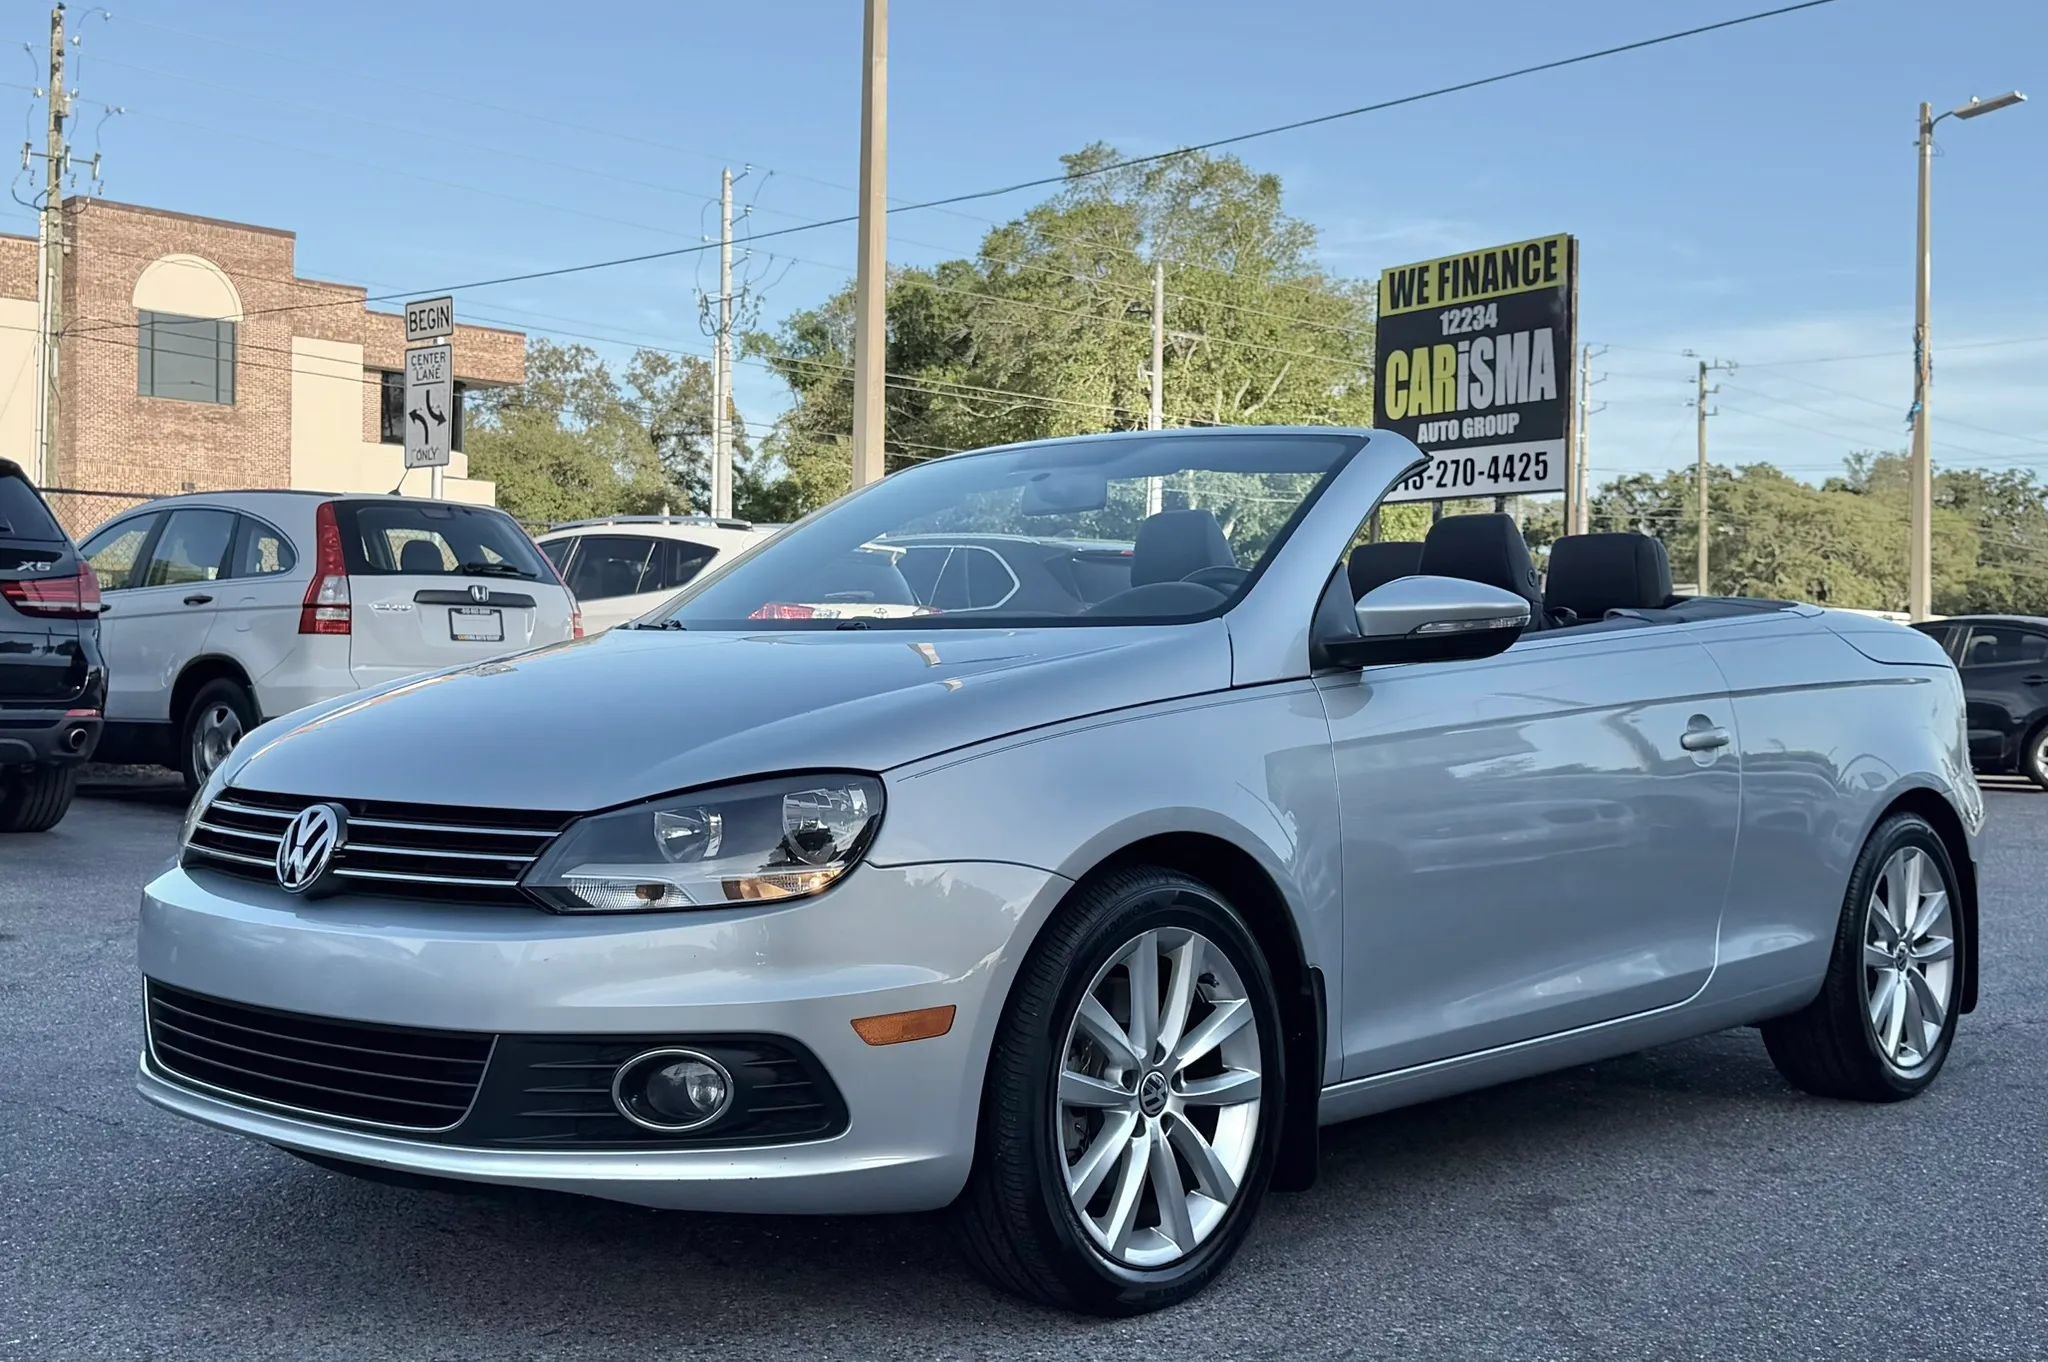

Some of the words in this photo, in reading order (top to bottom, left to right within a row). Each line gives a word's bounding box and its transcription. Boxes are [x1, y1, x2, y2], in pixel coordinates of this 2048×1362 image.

[1389, 265, 1430, 310] WE
[1438, 240, 1557, 301] FINANCE
[409, 305, 450, 333] BEGIN
[1440, 303, 1498, 335] 12234
[411, 352, 446, 367] CENTER
[416, 367, 441, 382] LANE
[1417, 419, 1459, 444] AUTO
[1462, 412, 1520, 439] GROUP
[416, 447, 439, 461] ONLY
